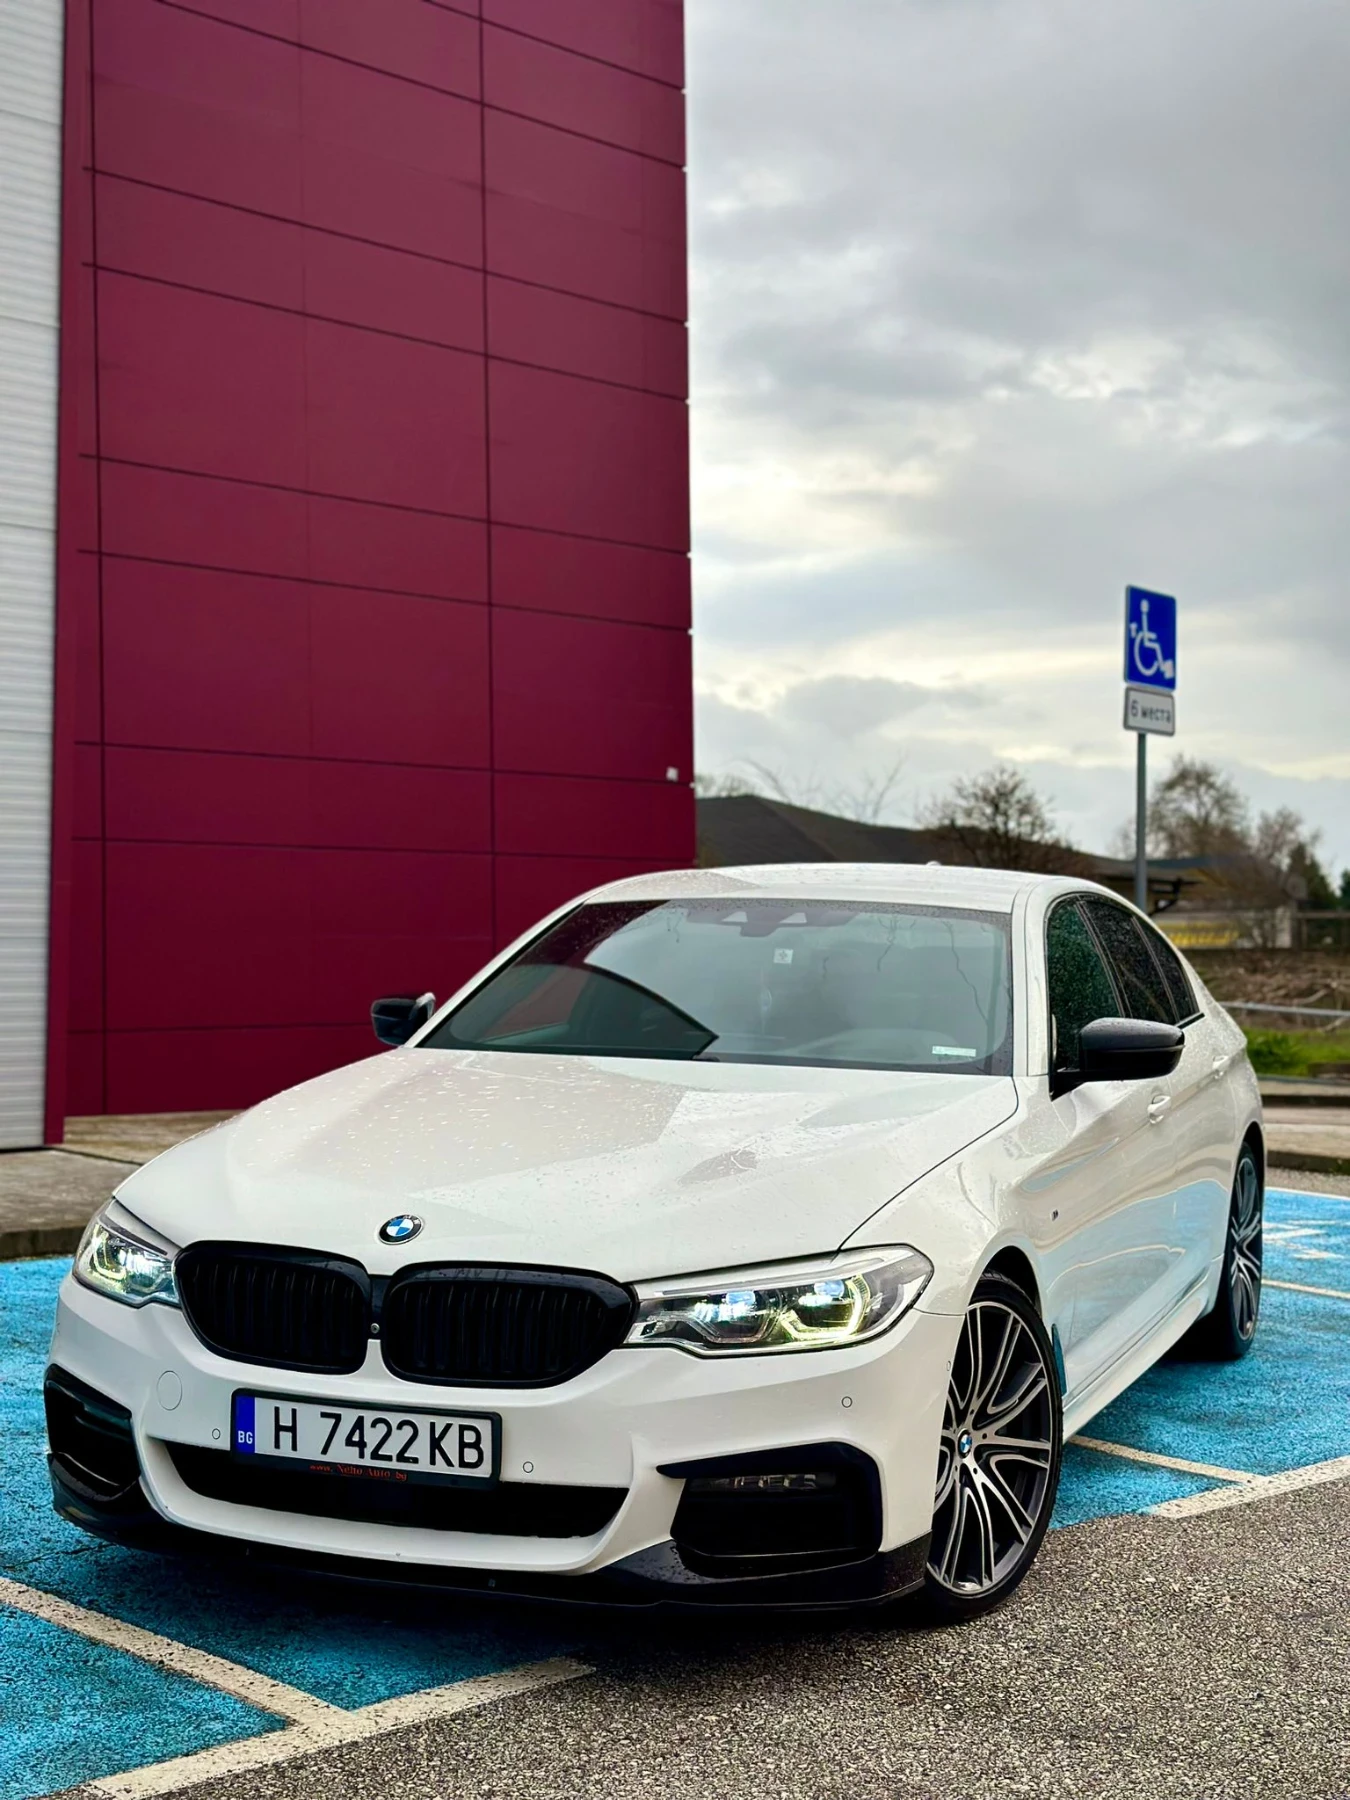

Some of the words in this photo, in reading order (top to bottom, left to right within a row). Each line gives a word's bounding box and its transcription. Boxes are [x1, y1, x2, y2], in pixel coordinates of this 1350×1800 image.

[1131, 699, 1139, 718] 6
[238, 1430, 253, 1444] BG
[273, 1406, 298, 1452] H
